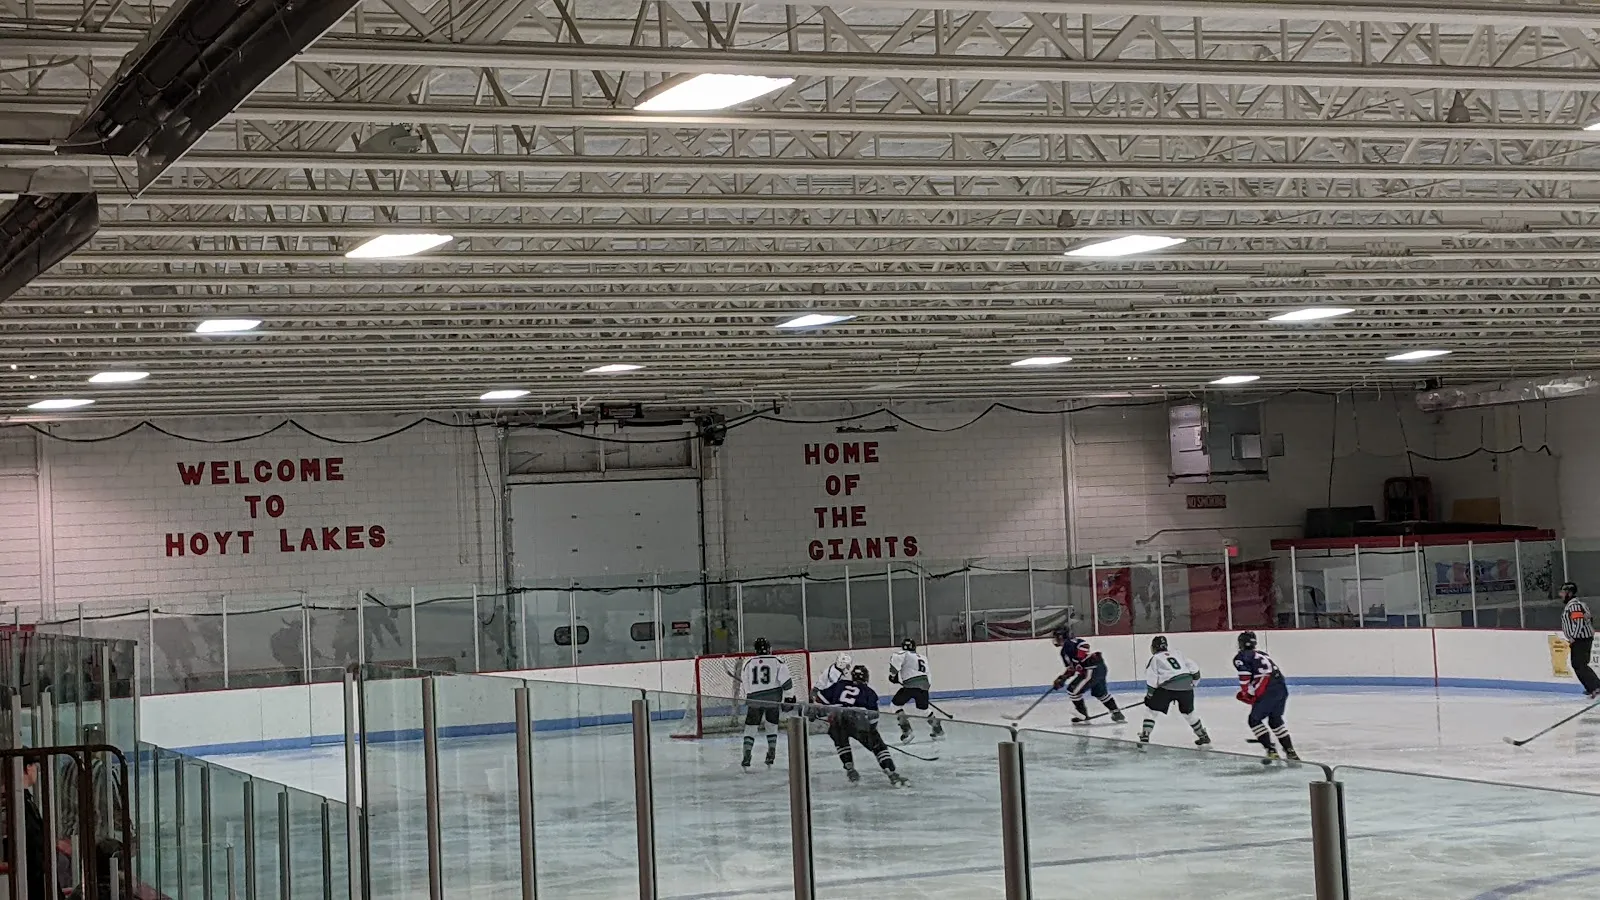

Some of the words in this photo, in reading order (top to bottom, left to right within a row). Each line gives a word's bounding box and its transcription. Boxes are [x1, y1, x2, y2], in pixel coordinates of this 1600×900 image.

[804, 441, 879, 465] HOME
[177, 457, 344, 486] WELCOME
[825, 474, 860, 496] OF
[244, 494, 285, 519] TO
[814, 505, 867, 529] THE
[165, 530, 254, 557] HOYT
[279, 524, 386, 552] LAKES
[808, 535, 918, 561] GIANTS
[751, 665, 771, 685] 13
[1166, 656, 1181, 670] 8
[839, 685, 861, 704] 2
